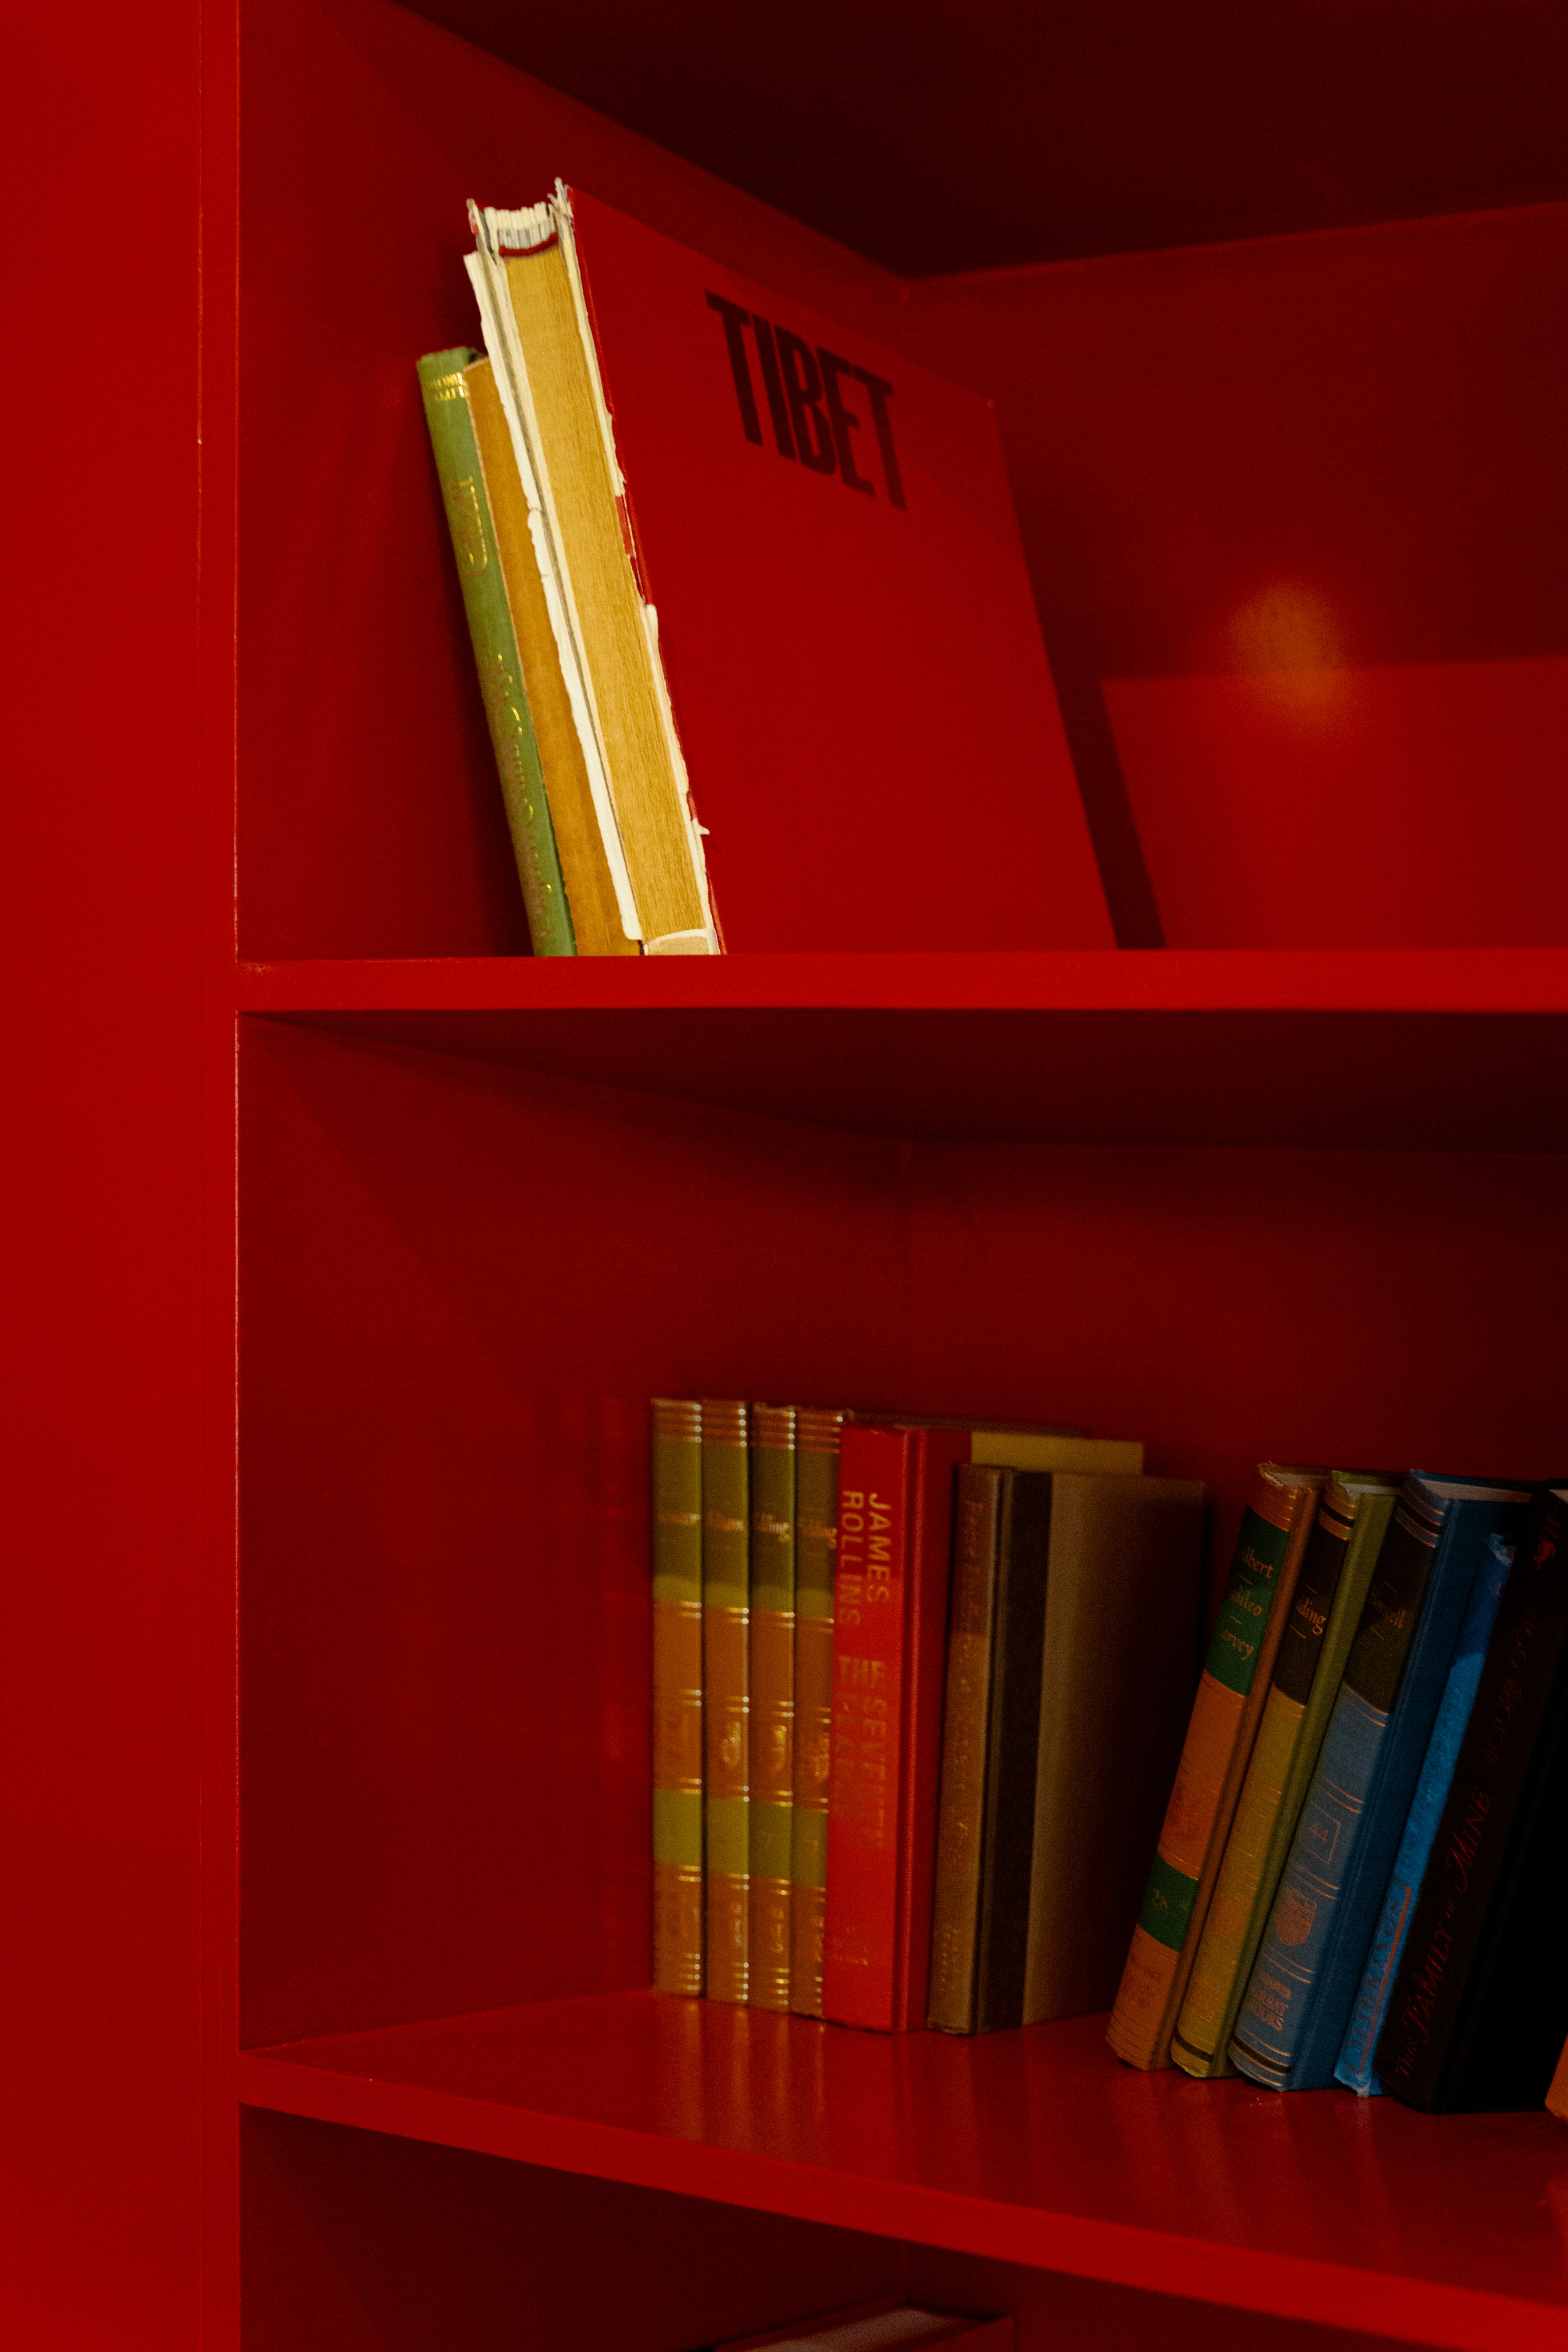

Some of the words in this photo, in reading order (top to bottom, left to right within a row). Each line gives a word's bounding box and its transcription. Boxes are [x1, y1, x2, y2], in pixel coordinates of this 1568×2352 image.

[705, 290, 907, 512] TIBET
[837, 1489, 866, 1626] ROLLINS
[865, 1492, 892, 1602] JAMES
[1218, 1628, 1254, 1661] arvey
[1403, 1919, 1453, 2045] FAMILY
[1446, 1785, 1491, 1893] MINE
